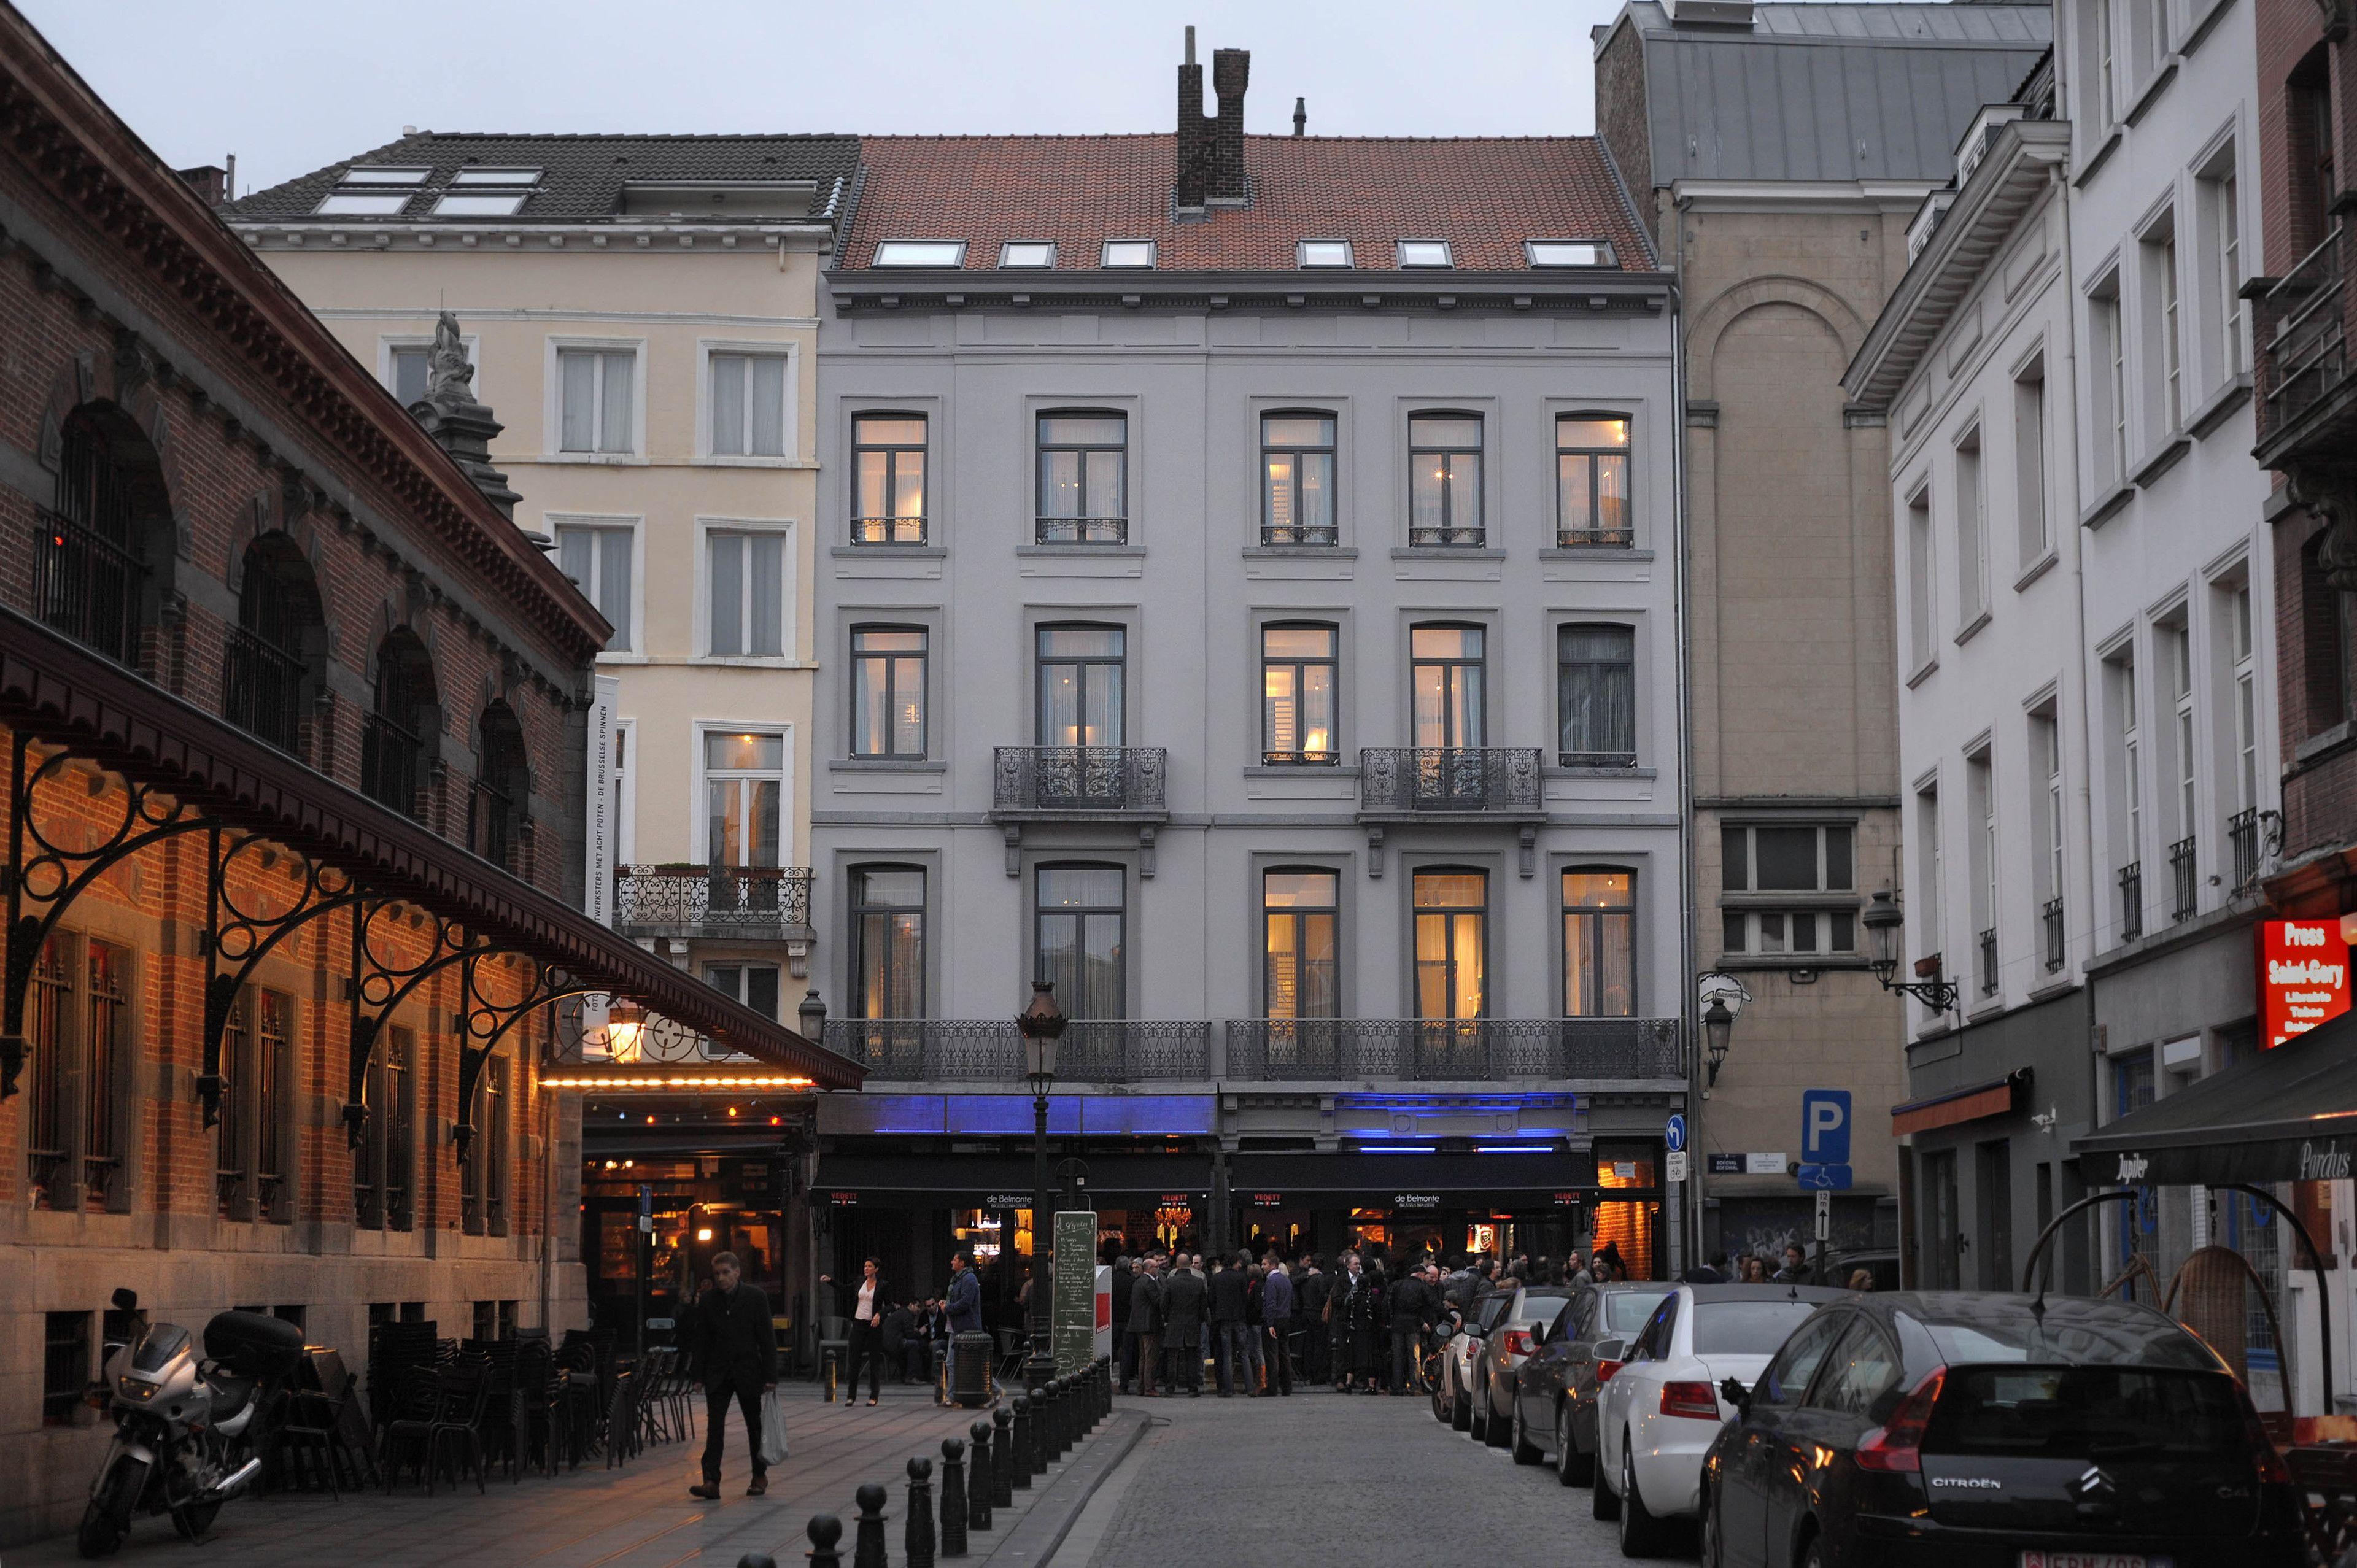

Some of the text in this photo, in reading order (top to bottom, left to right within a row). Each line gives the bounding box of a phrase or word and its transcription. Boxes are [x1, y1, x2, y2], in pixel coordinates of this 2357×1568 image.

[598, 786, 605, 796] DE
[2285, 922, 2326, 946] Press
[1809, 1101, 1843, 1151] P
[2299, 1140, 2350, 1179] Pardus
[2116, 1153, 2148, 1185] Jupiler
[999, 1194, 1032, 1203] Belmonte
[1395, 1194, 1440, 1202] de Belmonte
[1932, 1477, 2001, 1489] CITROËN
